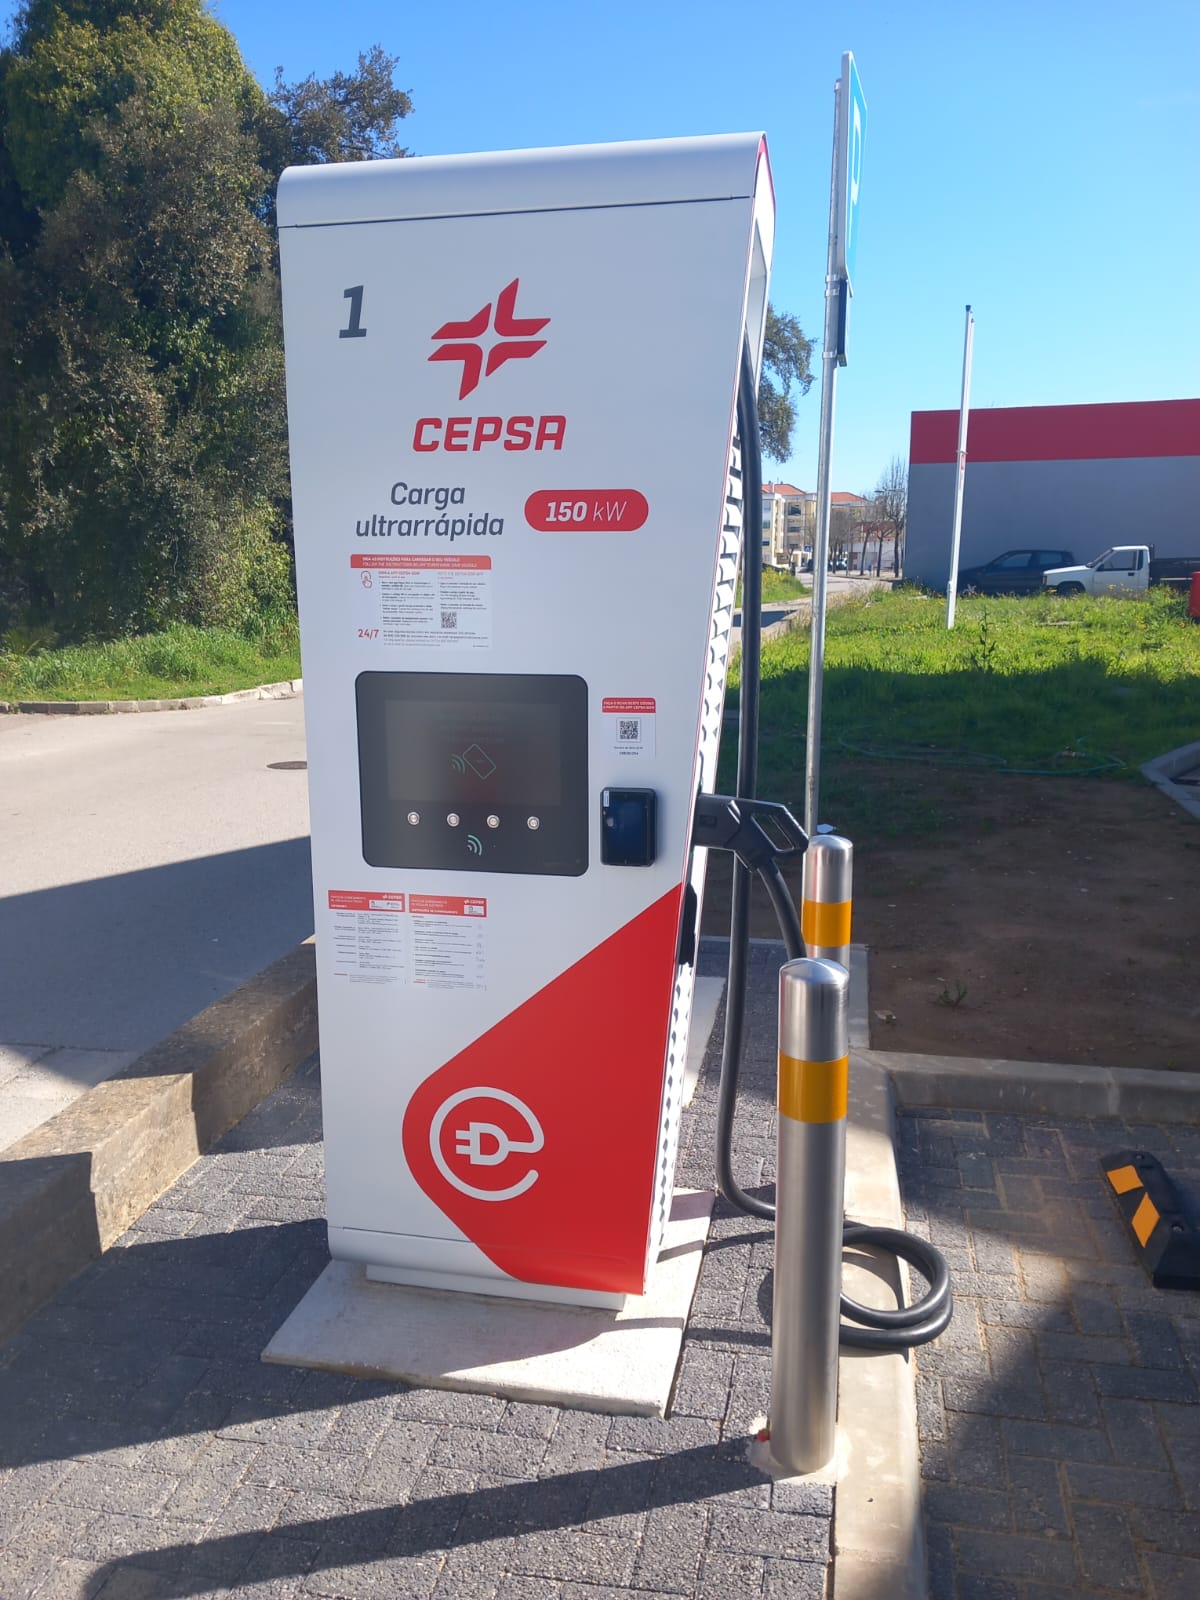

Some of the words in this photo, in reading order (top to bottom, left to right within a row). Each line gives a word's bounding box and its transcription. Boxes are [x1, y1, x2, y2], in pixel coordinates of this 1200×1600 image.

[338, 284, 367, 338] 1
[412, 415, 566, 452] CEPSA
[389, 481, 465, 509] Carga
[545, 501, 588, 522] 150
[592, 501, 627, 521] kW
[355, 512, 504, 541] ultrarrápida
[357, 629, 379, 640] 24/7
